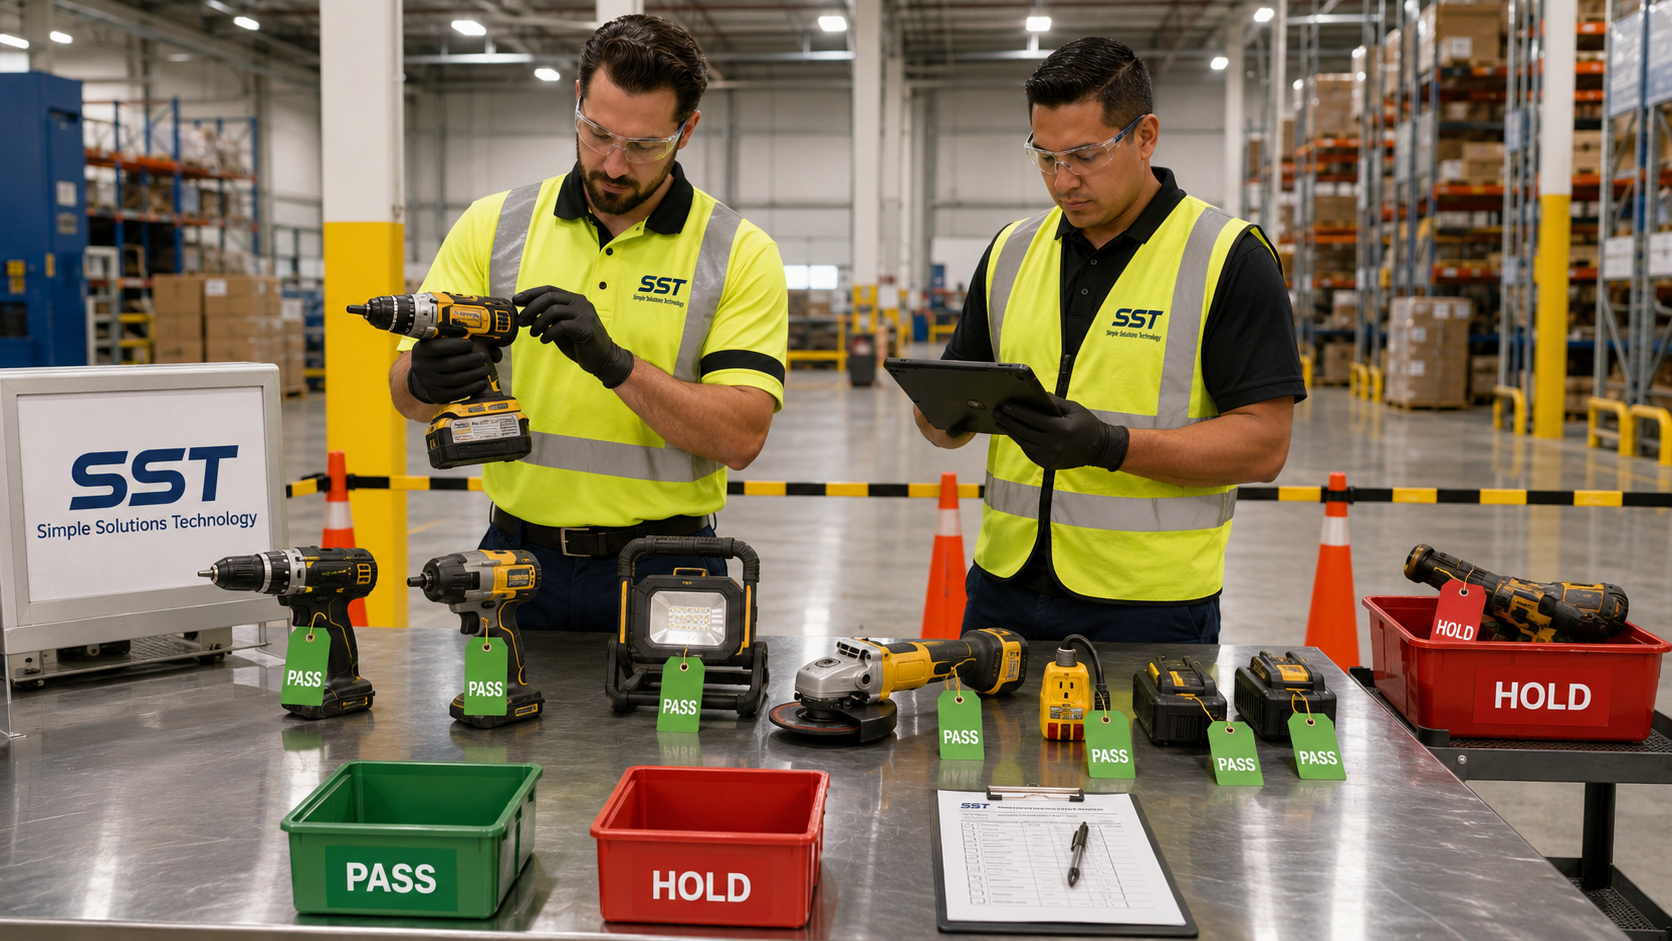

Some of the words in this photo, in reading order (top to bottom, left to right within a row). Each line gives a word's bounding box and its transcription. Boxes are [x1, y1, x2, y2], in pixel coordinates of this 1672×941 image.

[638, 275, 687, 296] SST
[1112, 308, 1164, 330] SST
[69, 444, 239, 511] SST
[37, 520, 91, 541] Simple
[95, 516, 167, 535] Solutions
[171, 510, 258, 530] Technology
[1436, 618, 1474, 641] HOLD
[286, 669, 322, 687] PASS
[468, 680, 504, 698] PASS
[1494, 681, 1592, 711] HOLD
[662, 698, 698, 716] PASS
[943, 729, 979, 745] PASS
[1091, 748, 1129, 764] PASS
[1217, 757, 1257, 772] PASS
[1298, 750, 1338, 766] PASS
[346, 862, 437, 894] PASS
[652, 869, 752, 903] HOLD
